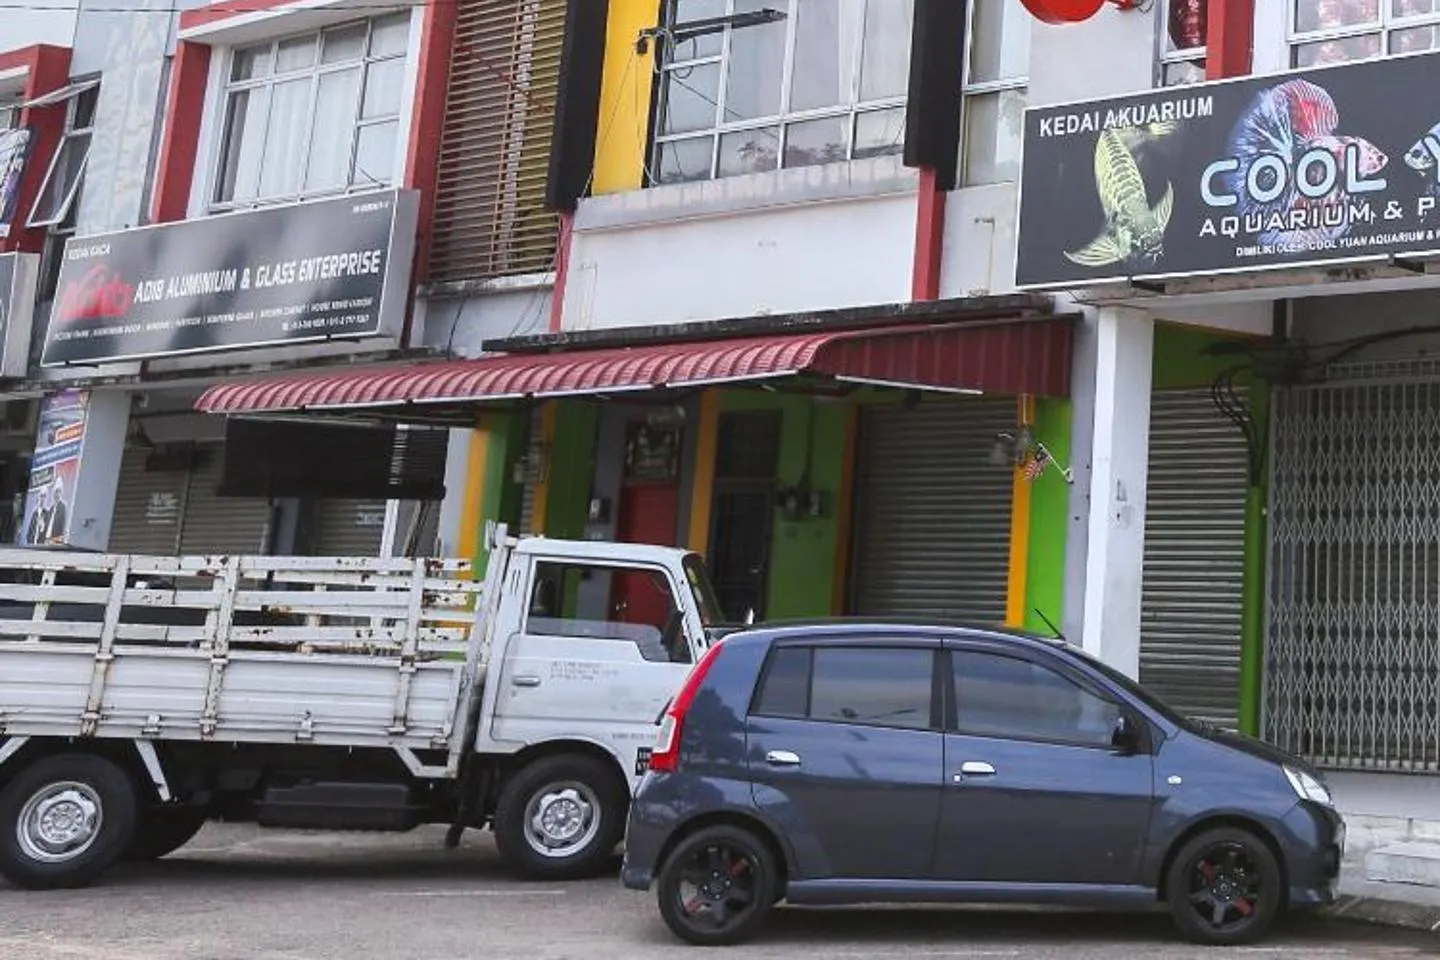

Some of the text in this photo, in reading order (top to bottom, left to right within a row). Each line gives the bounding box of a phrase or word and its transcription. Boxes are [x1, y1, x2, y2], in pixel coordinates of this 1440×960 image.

[1039, 95, 1213, 138] KEDAI AKUARIUM
[1200, 146, 1388, 207] COOL
[1199, 203, 1370, 238] AQUARIUM
[1383, 199, 1403, 221] &
[255, 260, 297, 289] GLASS
[298, 248, 382, 283] ENTERPRISE
